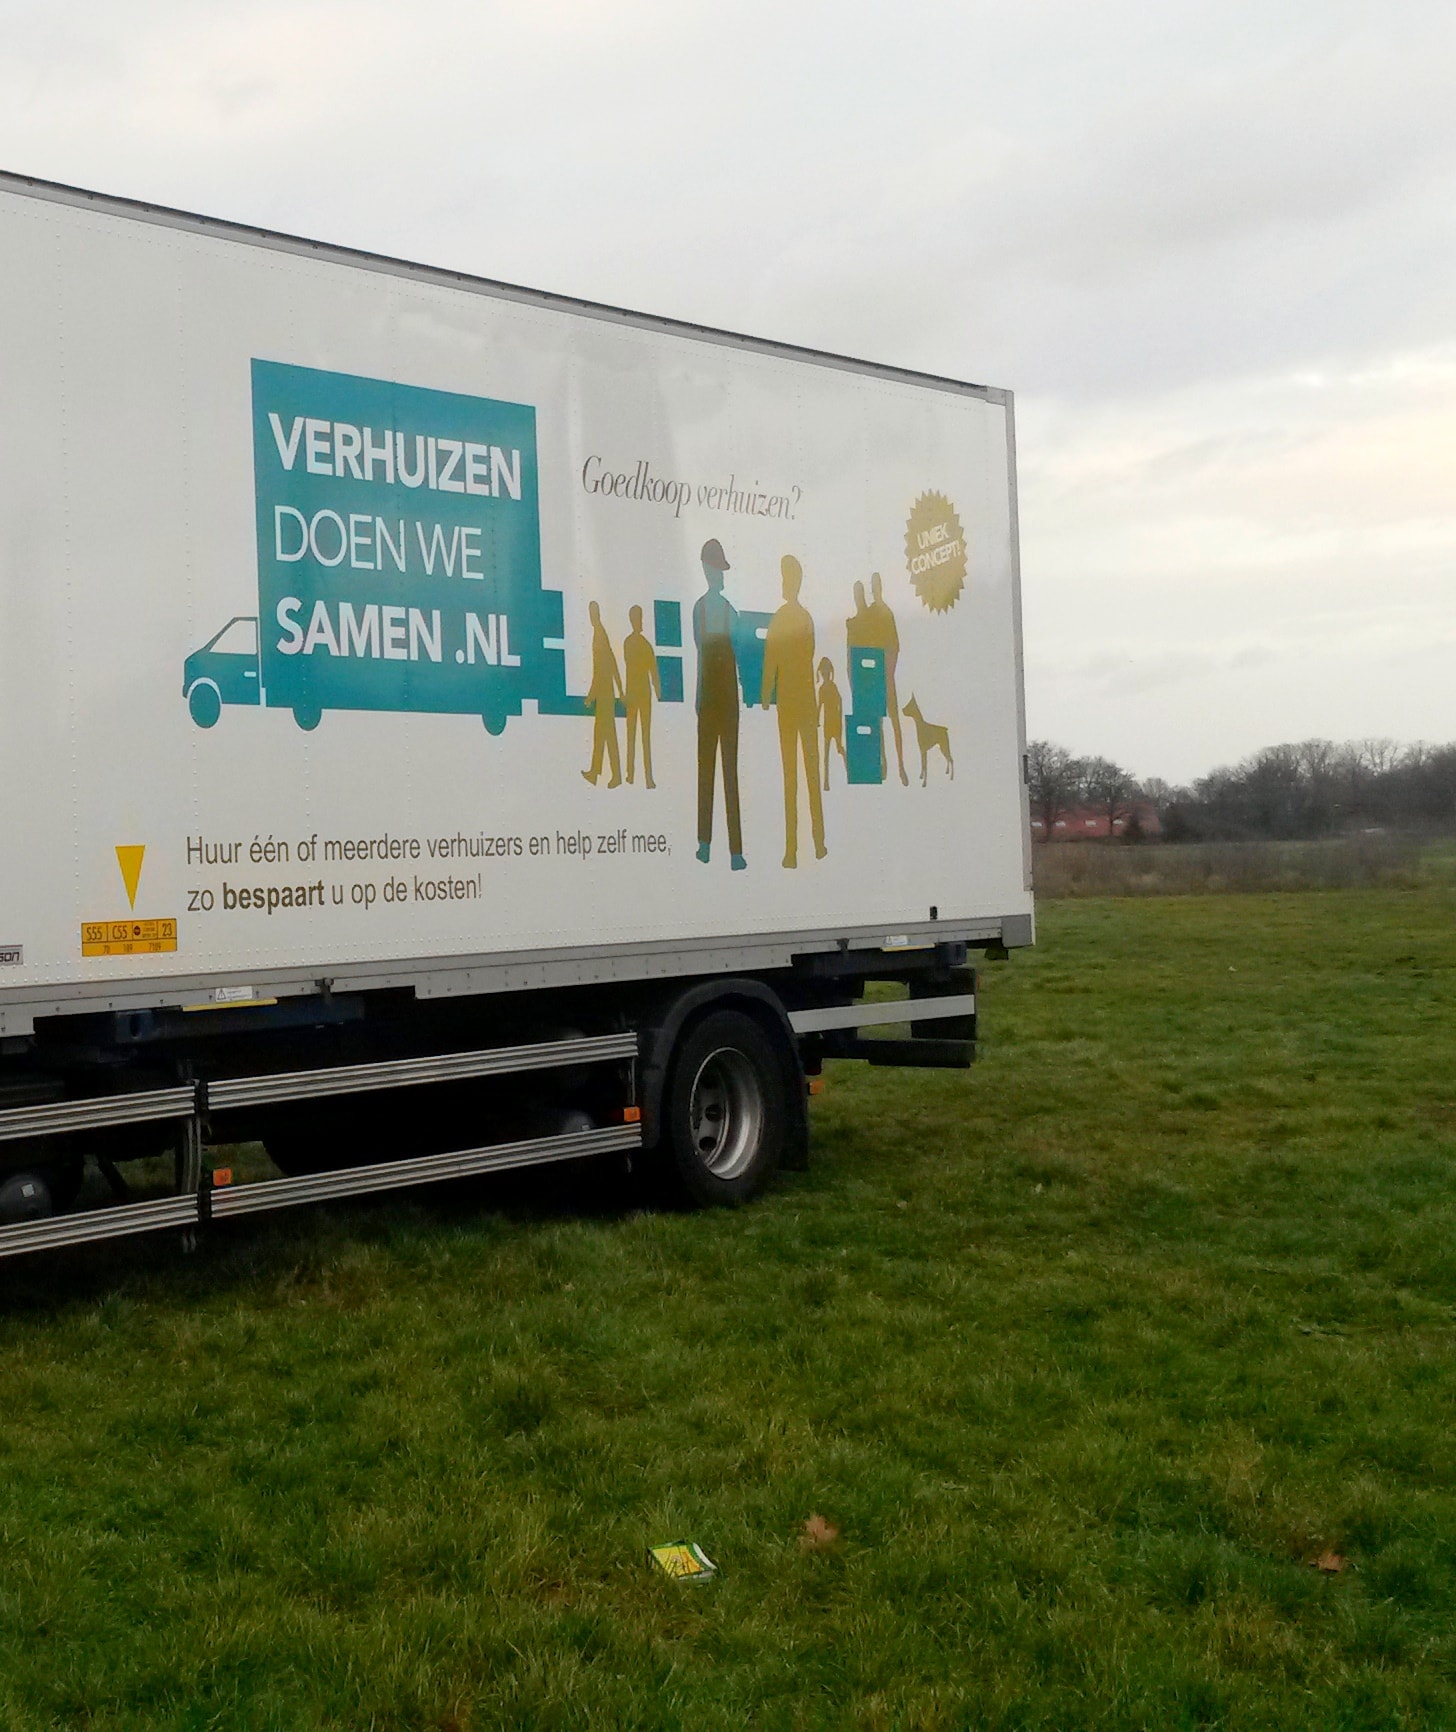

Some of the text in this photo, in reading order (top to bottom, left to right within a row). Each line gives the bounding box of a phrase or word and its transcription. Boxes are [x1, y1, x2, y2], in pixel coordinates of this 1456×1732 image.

[268, 412, 522, 501] VERHUIZEN
[582, 455, 802, 520] Goedkoop verhuizen?
[274, 505, 484, 580] DOEN WE
[911, 540, 961, 574] CONCEPT!
[917, 522, 949, 550] UNIEK
[276, 597, 521, 666] SAMEN .NL
[186, 829, 671, 864] Huur één of meerdere verhuizers en help zelf mee,
[187, 873, 482, 915] zo bespaart u op de kosten!
[162, 922, 173, 937] 23
